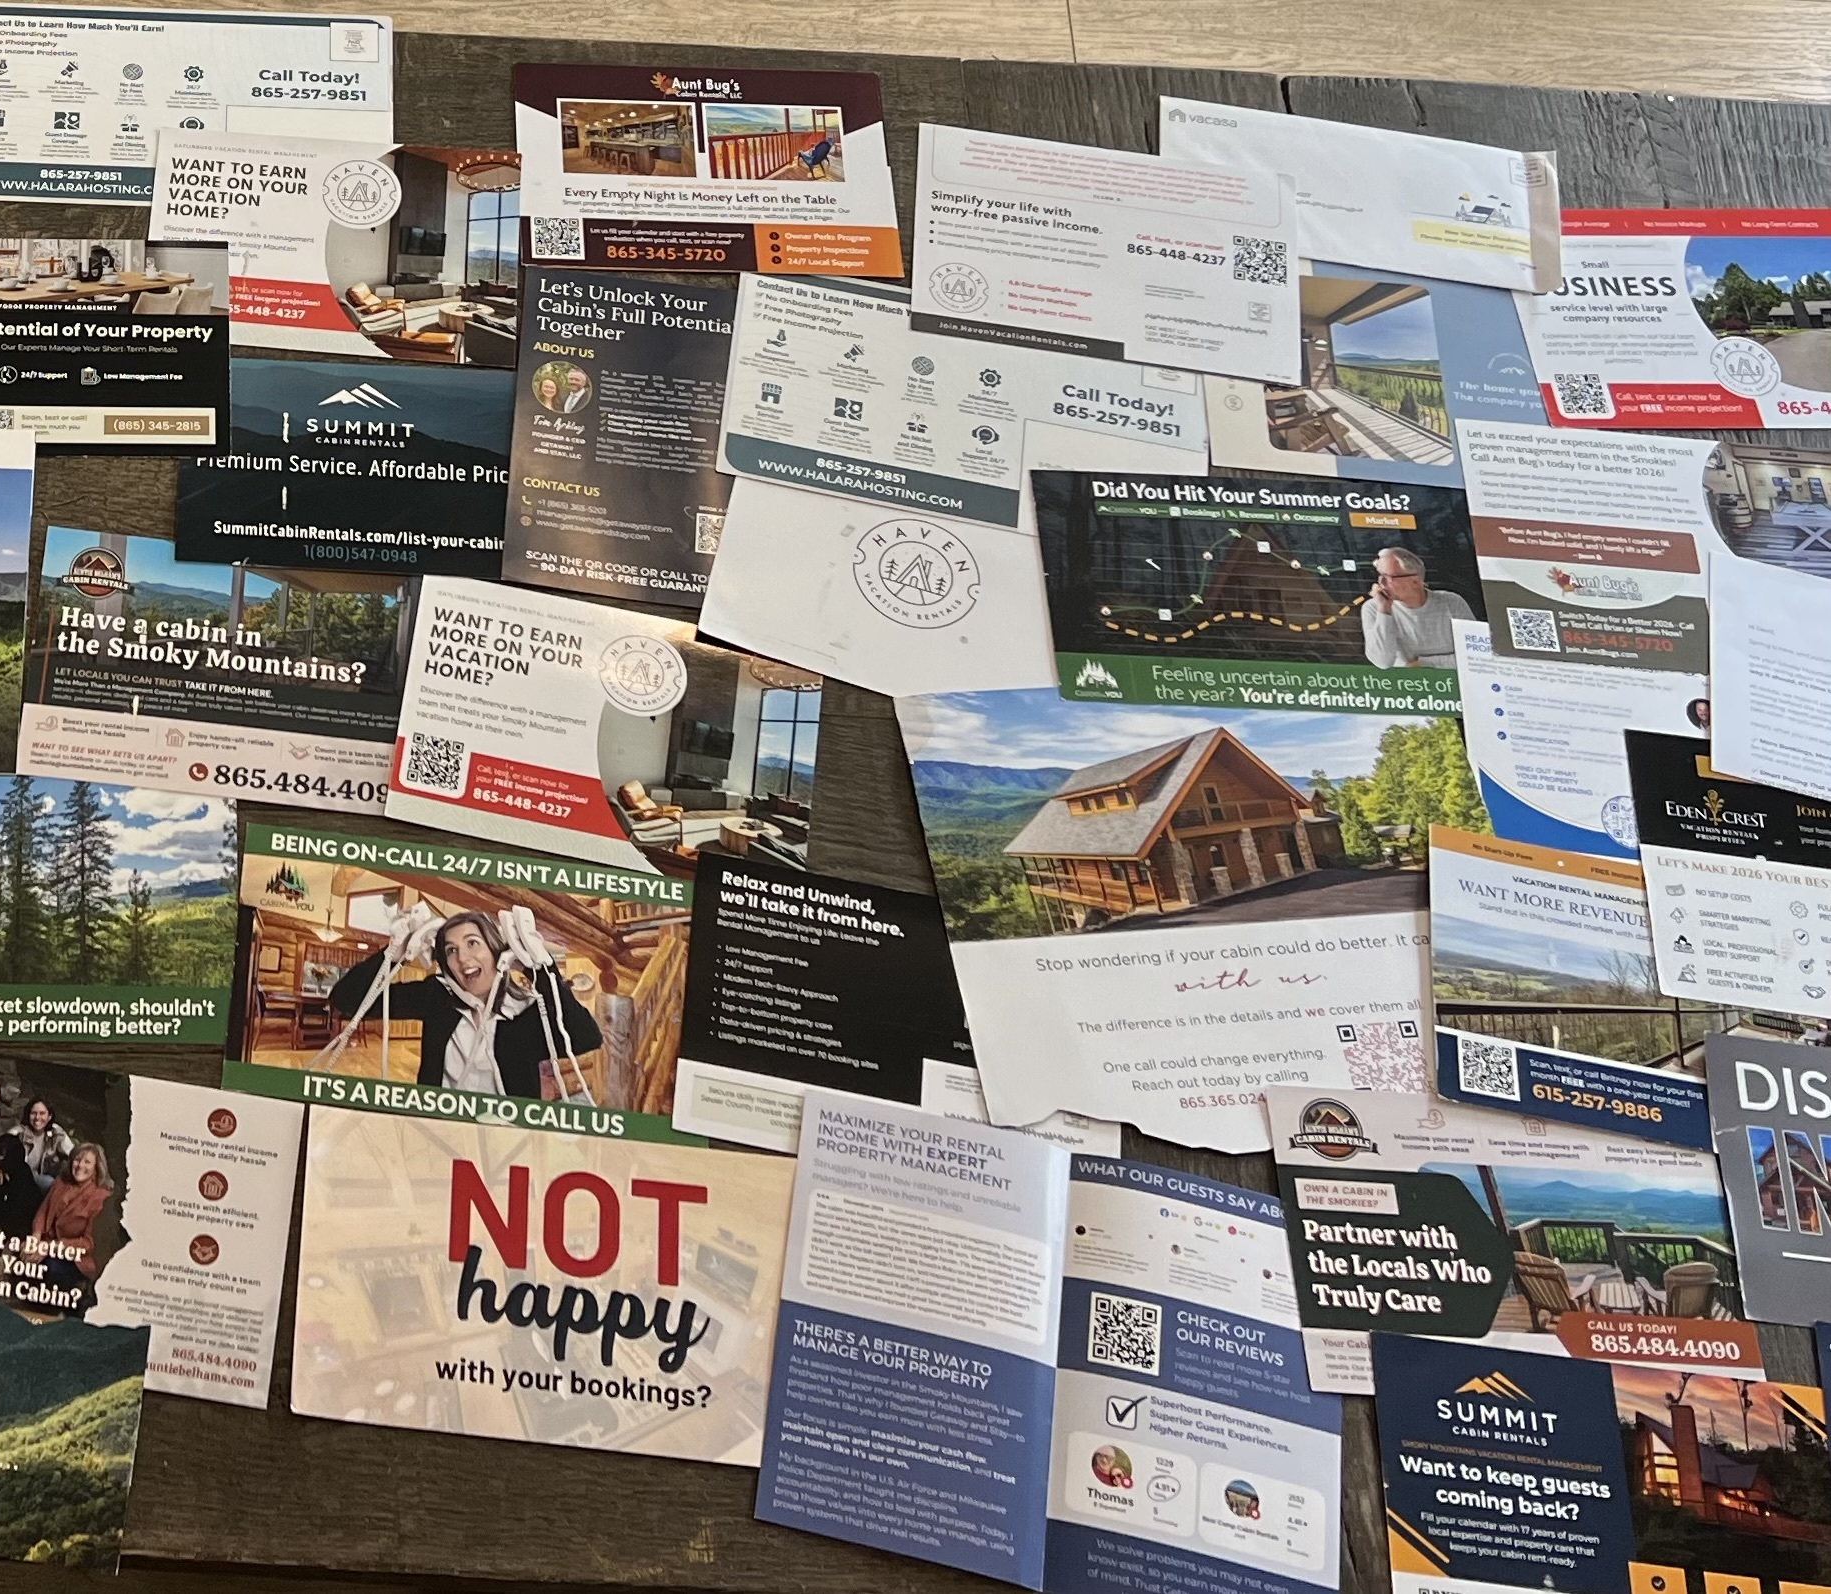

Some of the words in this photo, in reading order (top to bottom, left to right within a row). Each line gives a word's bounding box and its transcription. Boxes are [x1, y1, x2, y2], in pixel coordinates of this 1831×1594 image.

[17, 20, 27, 28] Us
[29, 21, 36, 29] to
[39, 20, 64, 29] Learn
[67, 21, 85, 30] How
[88, 22, 111, 31] Much
[115, 23, 138, 32] You'll
[141, 24, 164, 33] Earn!
[259, 70, 294, 82] Call
[298, 70, 360, 85] Today!
[671, 77, 702, 91] Aunt
[705, 78, 740, 93] Bug's
[251, 86, 367, 101] 865-257-9851
[564, 187, 597, 202] Every
[601, 189, 640, 202] Empty
[644, 189, 674, 204] Night
[678, 191, 688, 200] Is
[692, 191, 729, 206] Money
[734, 192, 759, 203] Left
[763, 194, 778, 204] on
[781, 194, 801, 204] the
[804, 194, 836, 205] Table
[607, 245, 726, 262] 865-345-5720
[1127, 243, 1226, 267] 865-448-4237
[539, 279, 584, 298] Let's
[589, 285, 655, 307] Unlock
[660, 293, 708, 312] Your
[21, 371, 37, 380] 24/7
[39, 371, 67, 380] Support
[112, 419, 146, 433] (865)
[148, 419, 201, 432] 345-2815
[315, 437, 351, 446] CABIN
[354, 439, 405, 448] RENTALS
[1092, 481, 1127, 499] Did
[1130, 483, 1169, 501] You
[1173, 485, 1206, 503] Hit
[1211, 487, 1255, 505] Your
[1259, 489, 1342, 509] Summer
[1346, 492, 1411, 511] Goals?
[303, 544, 418, 563] 1(800)547-0948
[472, 786, 572, 820] 865-448-4237
[1665, 800, 1708, 821] EDEN
[1723, 809, 1768, 829] CREST
[271, 833, 338, 859] BEING
[341, 841, 439, 871] ON-CALL
[442, 855, 492, 878] 24/7
[496, 862, 549, 884] ISN'T
[553, 869, 571, 887] A
[574, 872, 685, 901] LIFESTYLE
[722, 870, 769, 893] Relax
[771, 884, 805, 900] and
[808, 889, 876, 915] Unwind,
[1458, 879, 1510, 902] WANT
[1514, 890, 1565, 914] MORE
[1568, 899, 1648, 928] REVENUE
[1132, 1073, 1174, 1093] Reach
[1177, 1073, 1202, 1089] out
[1206, 1070, 1243, 1090] today
[1246, 1069, 1262, 1087] by
[1265, 1067, 1309, 1086] calling
[1532, 1084, 1663, 1123] 615-257-9886
[448, 1158, 709, 1287] NOT
[1302, 1219, 1399, 1251] Partner
[1403, 1226, 1458, 1252] with
[456, 1244, 711, 1373] happy
[1177, 1310, 1238, 1339] CHECK
[1237, 1324, 1267, 1345] OUT
[1587, 1320, 1616, 1333] CALL
[1619, 1322, 1634, 1333] US
[1637, 1322, 1677, 1336] TODAY!
[1589, 1335, 1741, 1362] 865.484.4090
[1399, 1454, 1457, 1479] Want
[1458, 1463, 1482, 1483] to
[1486, 1466, 1539, 1494] keep
[1542, 1474, 1612, 1500] guests
